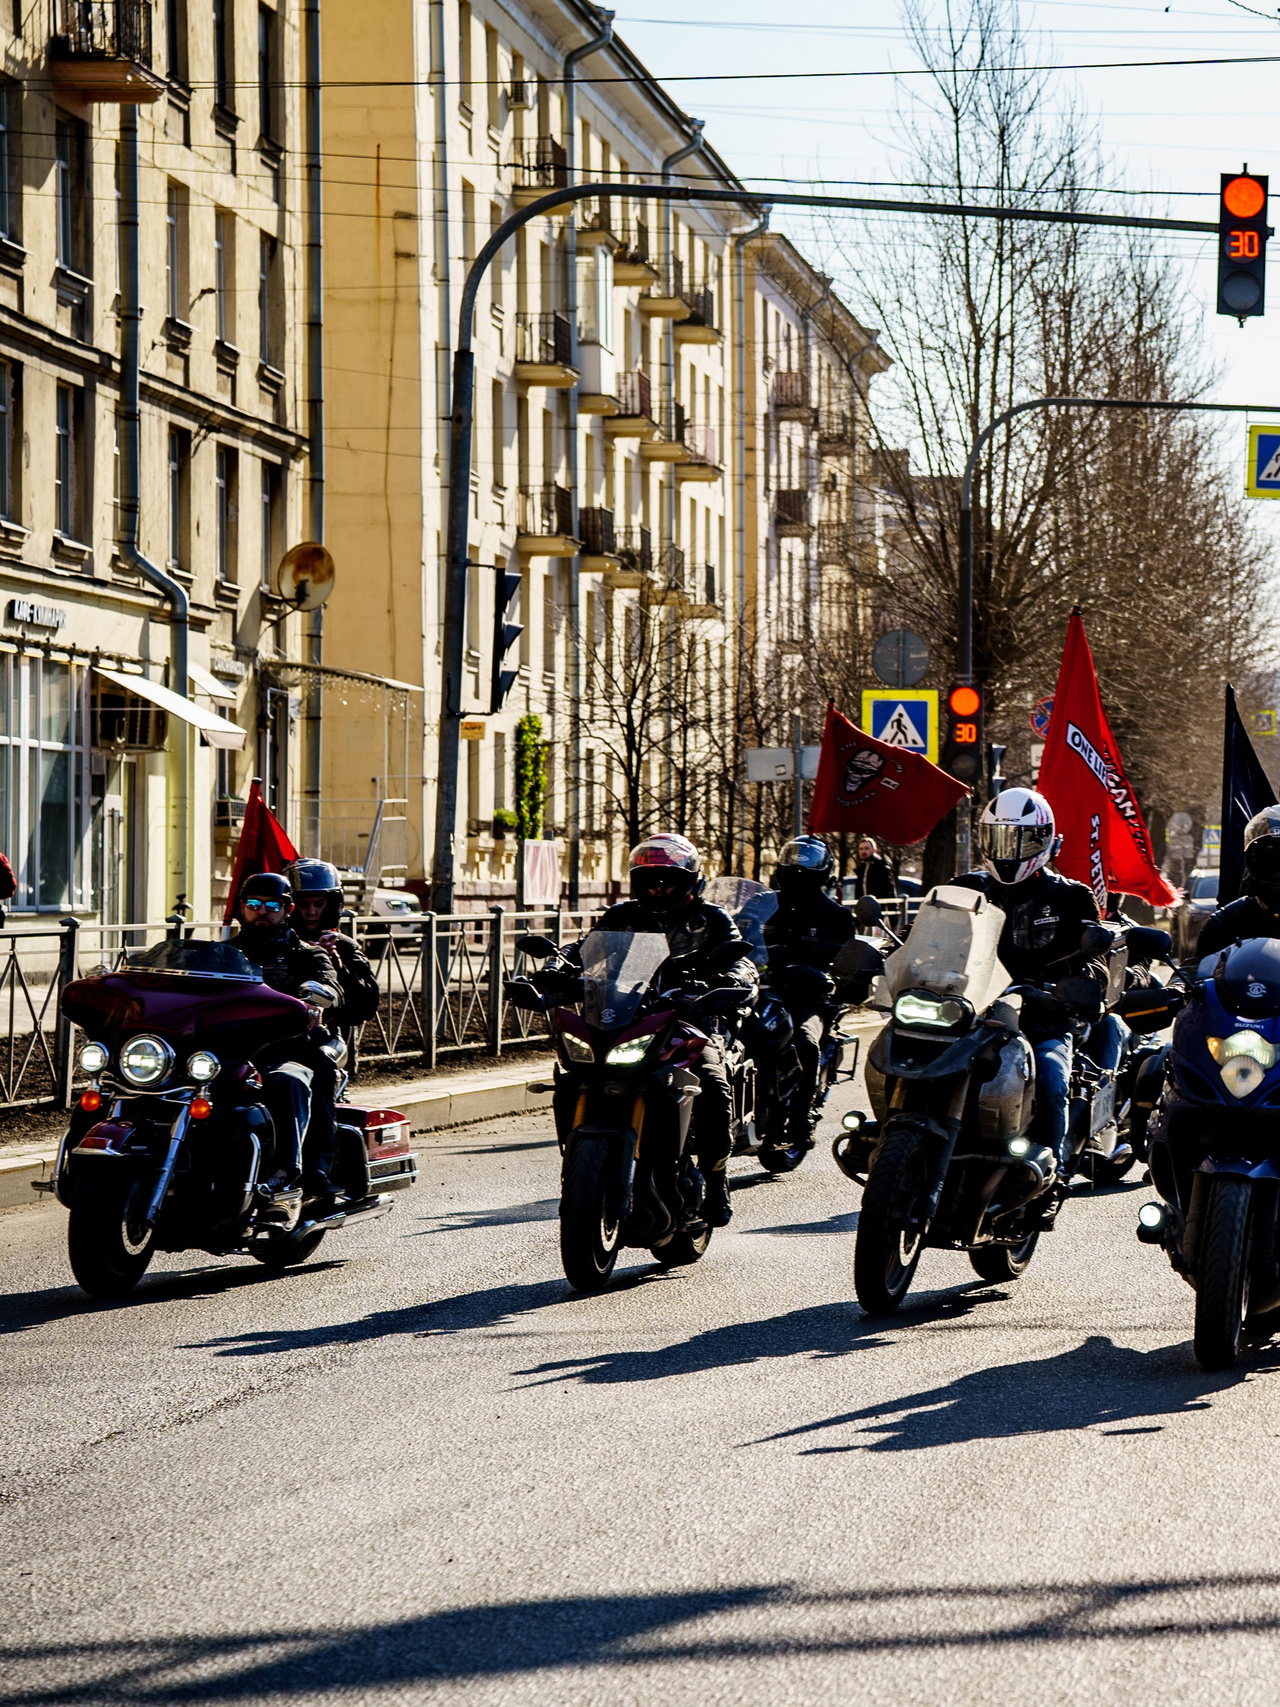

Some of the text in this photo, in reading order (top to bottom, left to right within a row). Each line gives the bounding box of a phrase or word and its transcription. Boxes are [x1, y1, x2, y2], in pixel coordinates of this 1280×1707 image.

[1230, 231, 1259, 257] 30
[955, 723, 977, 743] 30
[1071, 731, 1093, 764] ONE
[1090, 815, 1100, 849] ST.
